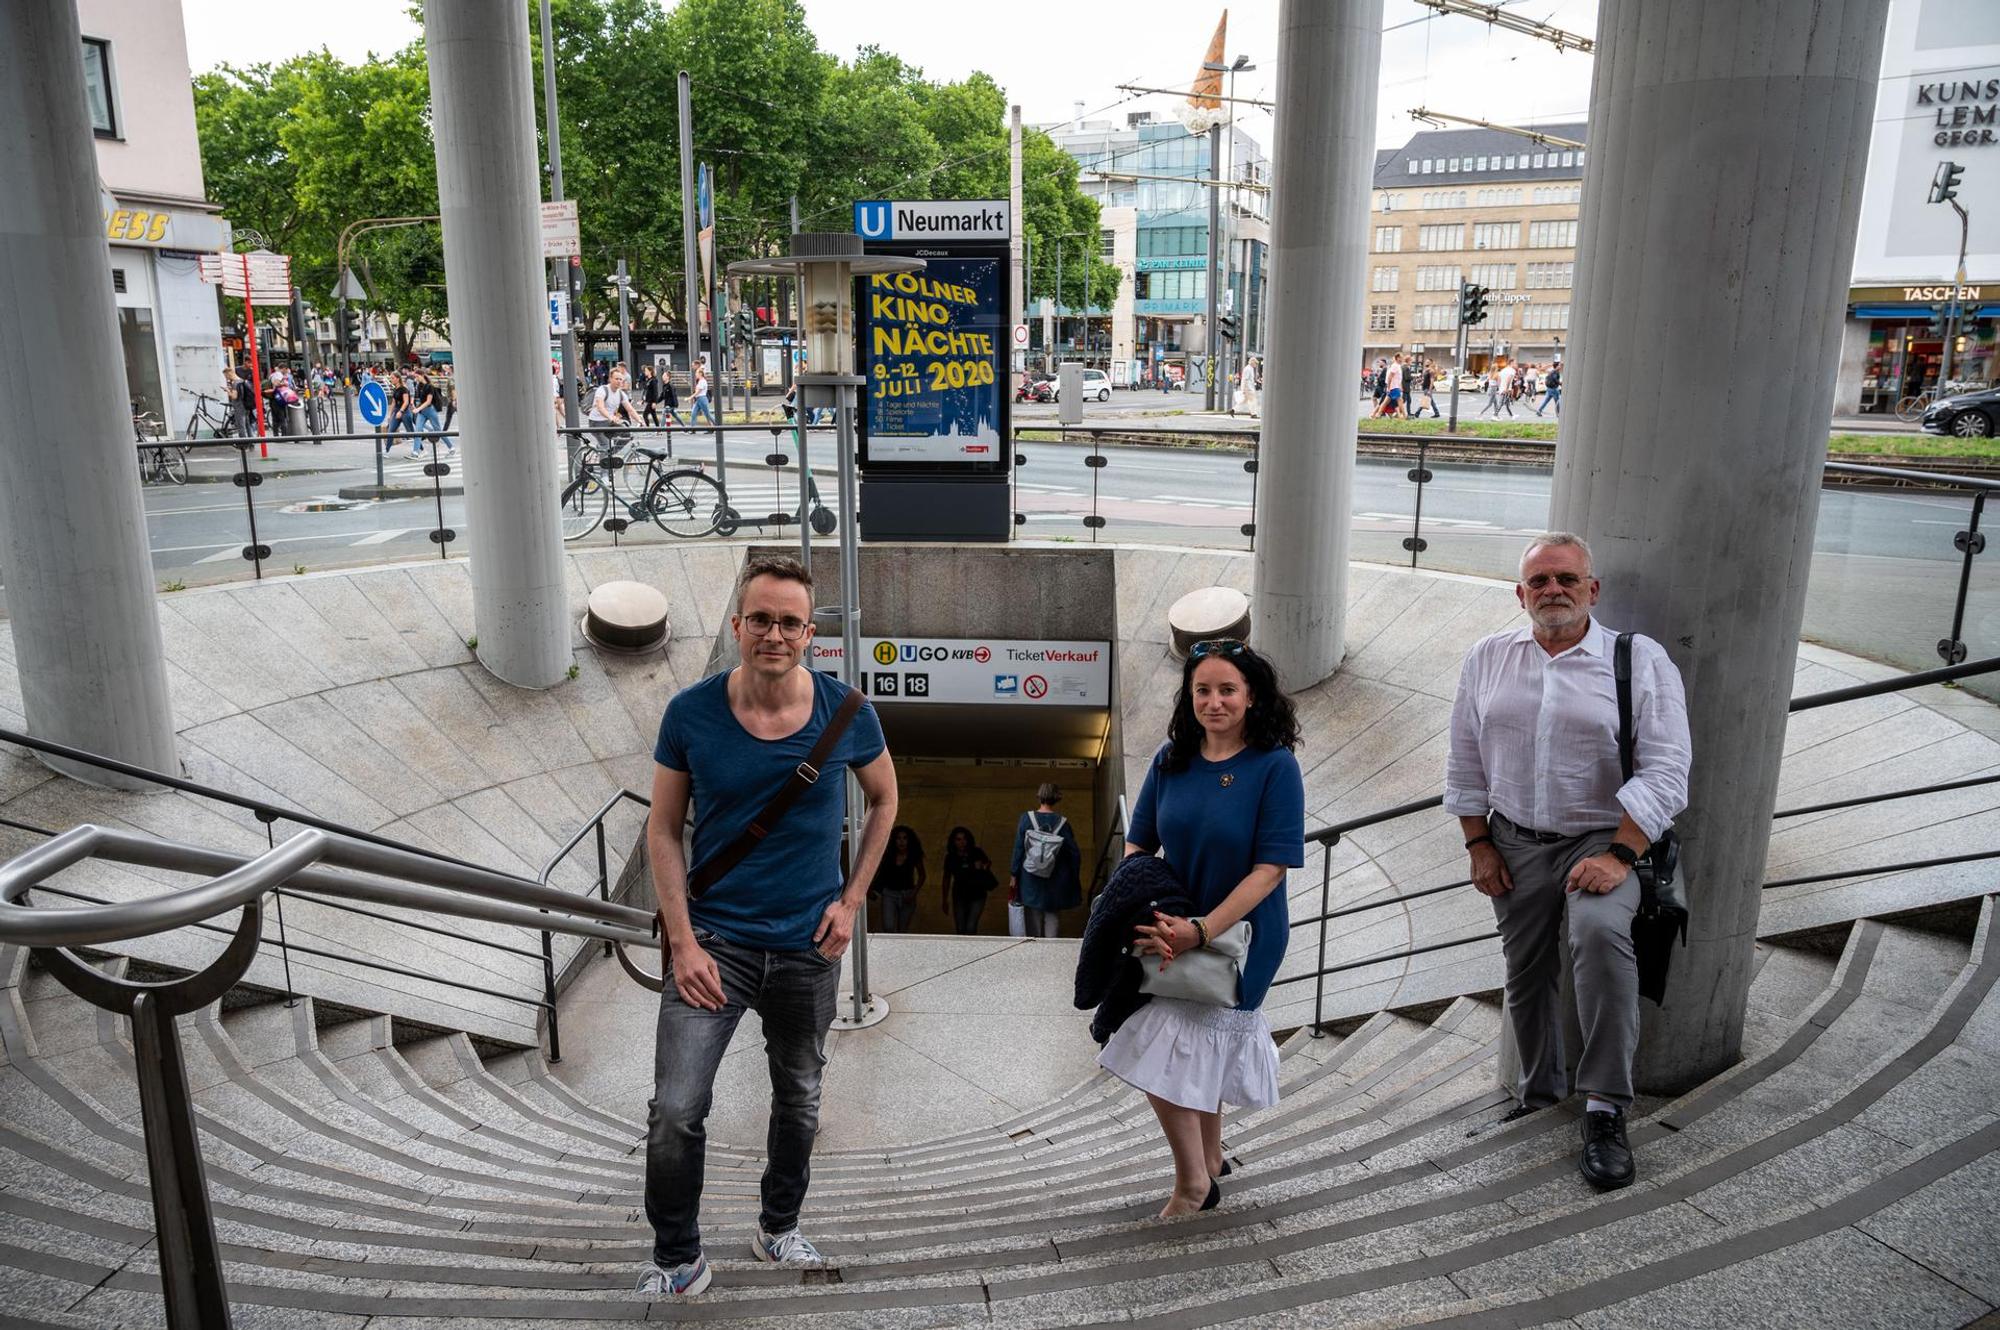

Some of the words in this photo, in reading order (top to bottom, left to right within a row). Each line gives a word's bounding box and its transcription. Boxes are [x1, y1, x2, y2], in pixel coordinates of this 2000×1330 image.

[1936, 104, 1997, 127] LEM
[104, 209, 170, 242] ESS
[861, 207, 885, 237] U
[898, 209, 1004, 232] Neumarkt
[915, 249, 949, 257] JCDecaux
[871, 271, 980, 306] KÖLNER
[1903, 286, 1981, 301] TASCHEN
[872, 294, 950, 325] KINO
[873, 322, 994, 356] NÄCHTE
[873, 379, 921, 398] JULI
[928, 360, 995, 391] 2020
[951, 649, 974, 660] KVB
[876, 676, 896, 692] 16
[907, 677, 927, 693] 18
